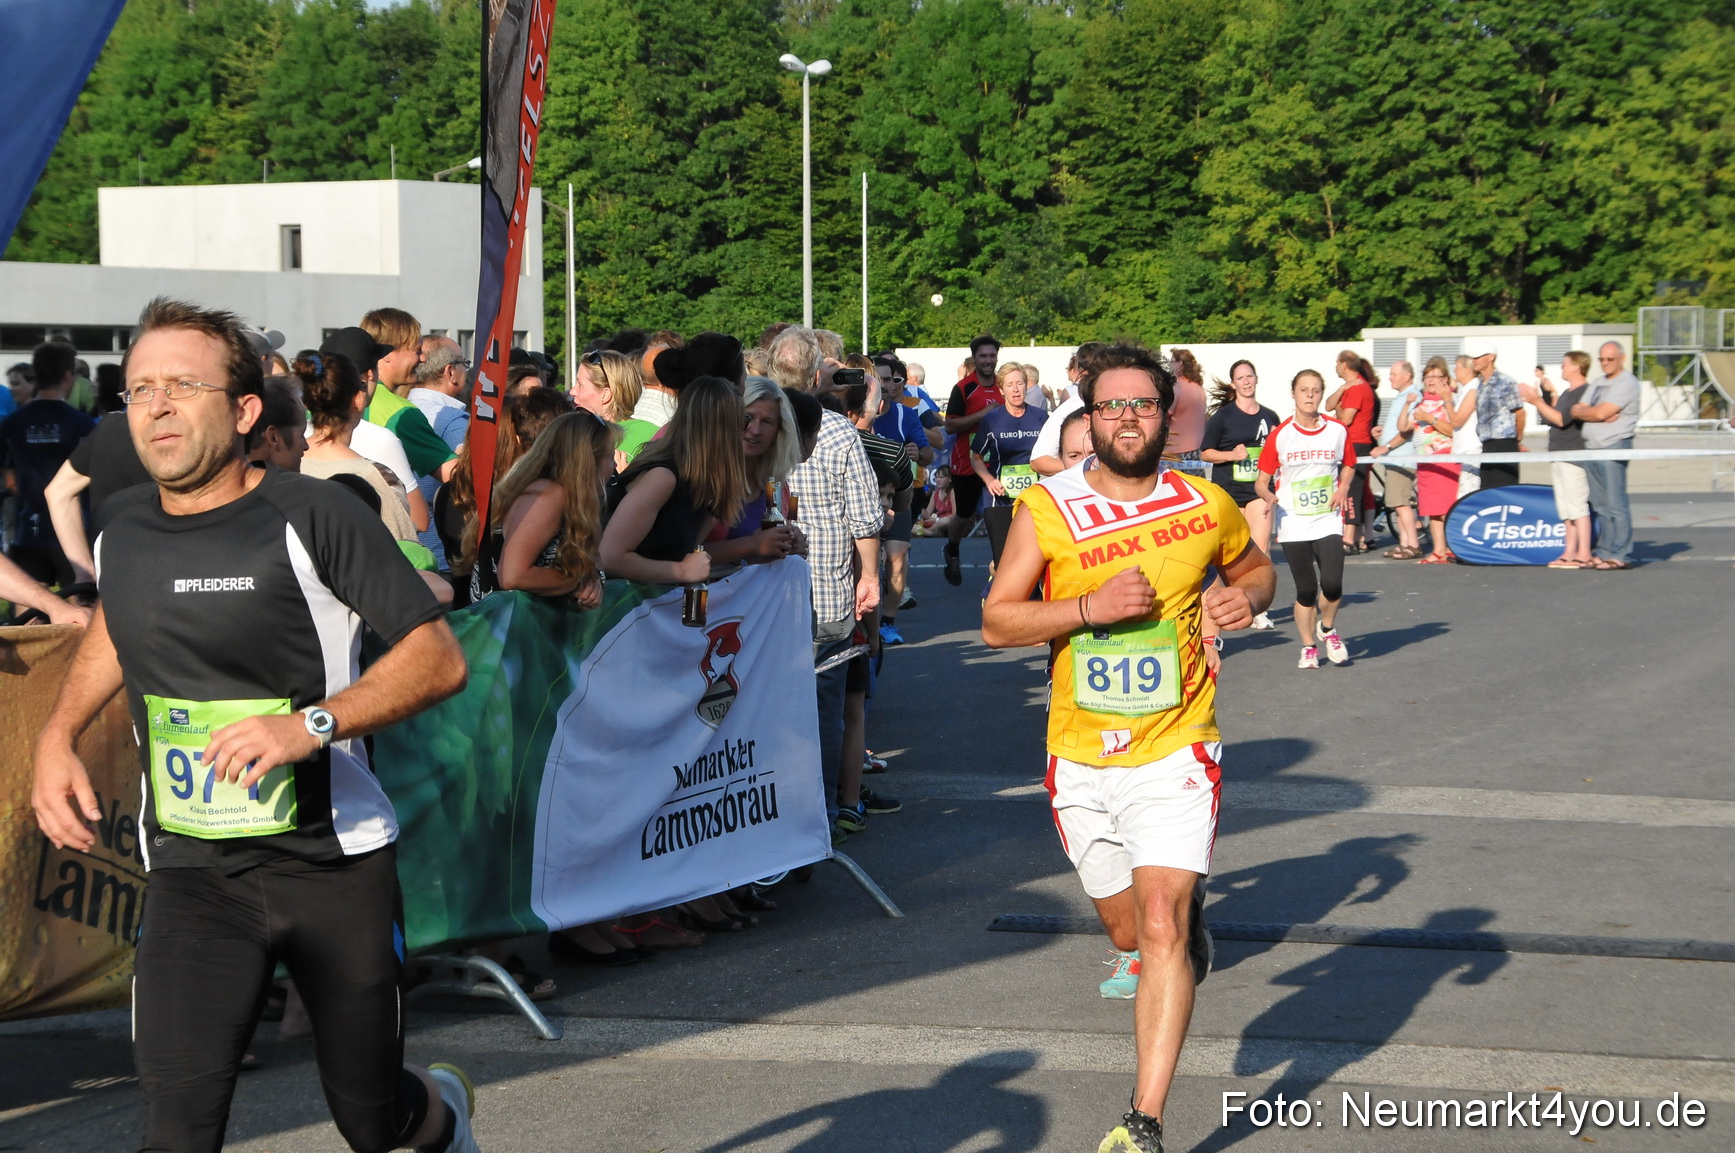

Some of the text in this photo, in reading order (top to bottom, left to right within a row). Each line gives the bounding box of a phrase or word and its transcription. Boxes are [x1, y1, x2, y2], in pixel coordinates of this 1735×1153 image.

[1000, 430, 1040, 439] EURO POLES
[1287, 450, 1336, 462] PFEIFFER
[1006, 476, 1032, 490] 359
[1299, 489, 1328, 507] 955
[1078, 513, 1218, 570] MAX BÖGL
[186, 576, 256, 593] PFLEIDERER
[1086, 656, 1162, 695] 819
[1125, 695, 1150, 703] Schmidt
[163, 721, 209, 735] firmenlauf
[189, 805, 247, 816] Klaus Bechtold
[196, 816, 250, 827] Holzwerkstoffe
[252, 815, 277, 824] GmbH
[641, 775, 779, 861] Lammsbräu
